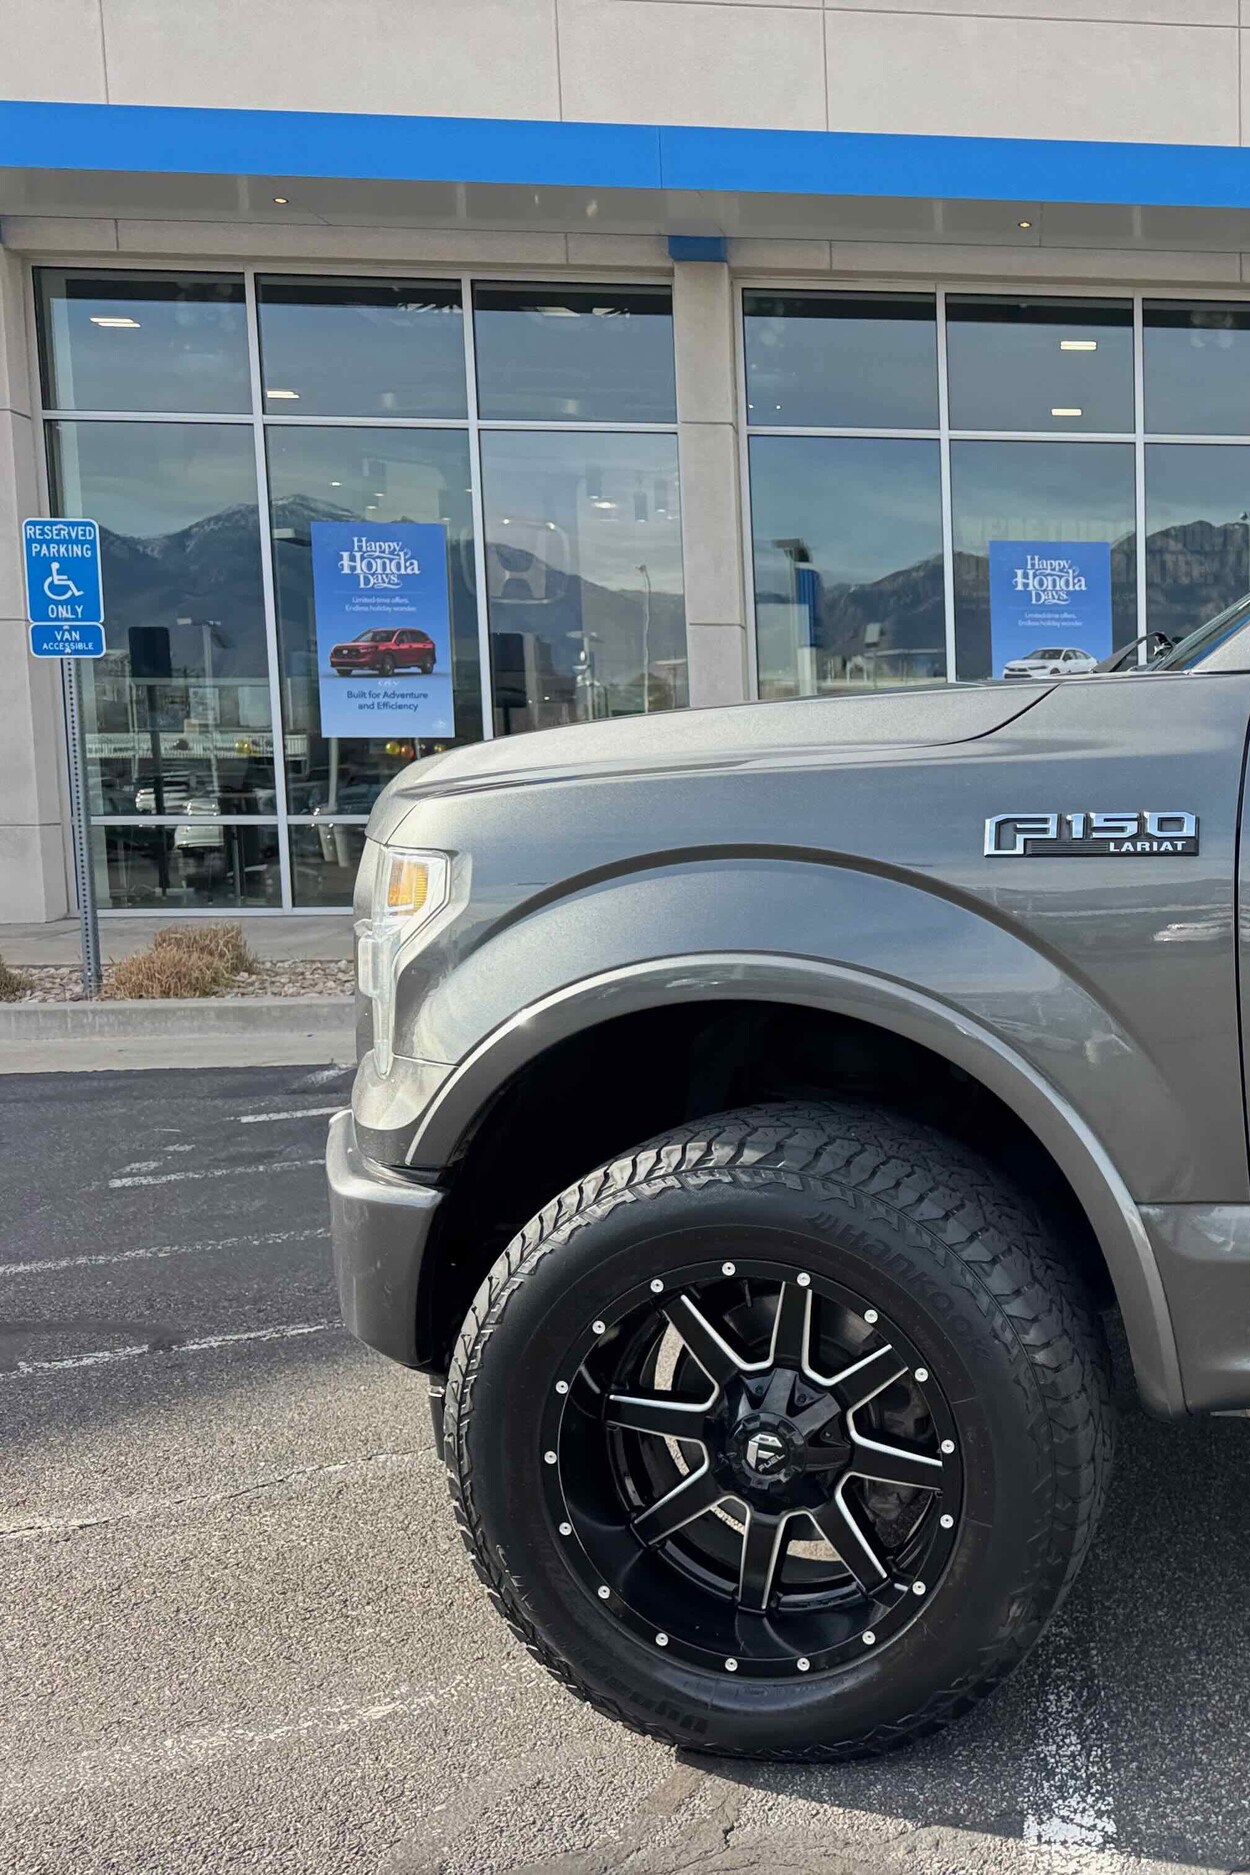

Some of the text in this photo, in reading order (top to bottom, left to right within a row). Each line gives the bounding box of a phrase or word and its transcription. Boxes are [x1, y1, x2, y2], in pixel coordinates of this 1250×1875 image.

[27, 525, 95, 540] RESERVED
[32, 543, 92, 558] PARKING
[352, 536, 403, 557] Happy
[338, 551, 421, 575] Honda
[1026, 555, 1071, 574] Happy
[1012, 569, 1087, 591] Honda
[48, 604, 84, 618] ONLY
[54, 631, 80, 641] VAN
[42, 642, 94, 651] ACCESSIBLE
[346, 690, 429, 699] Built for Adventure
[358, 701, 419, 713] and Efficiency
[1109, 841, 1187, 853] LARIAT
[757, 1454, 786, 1472] FUEL
